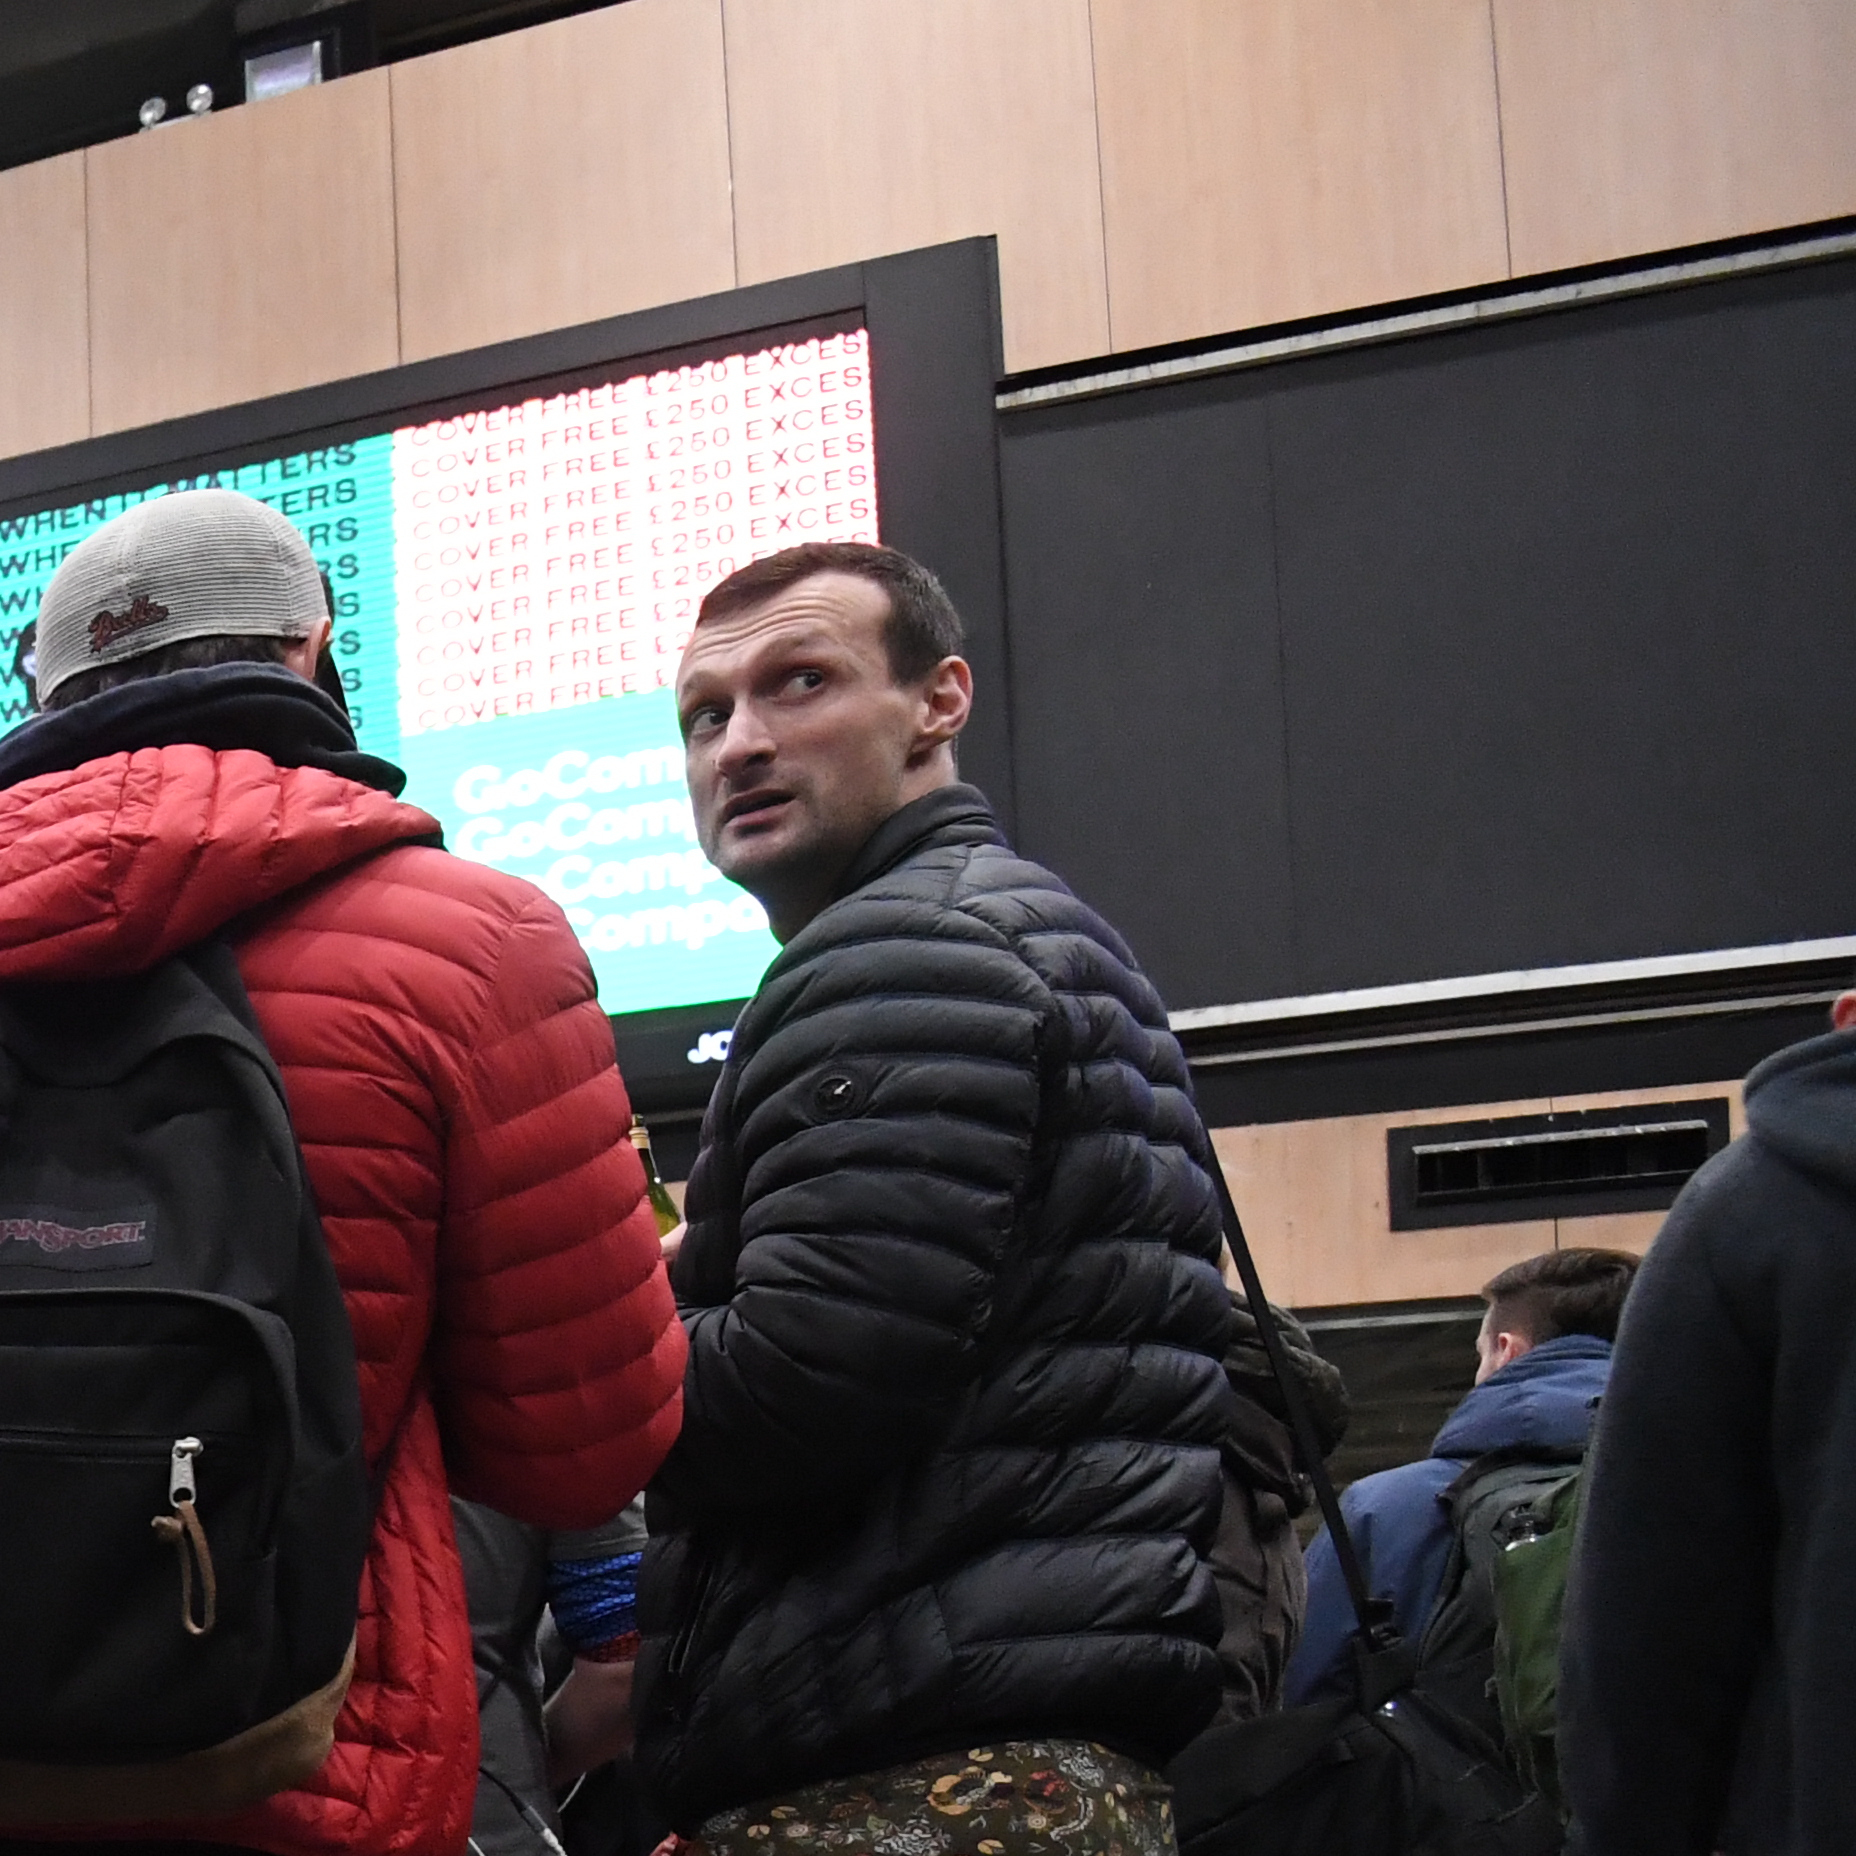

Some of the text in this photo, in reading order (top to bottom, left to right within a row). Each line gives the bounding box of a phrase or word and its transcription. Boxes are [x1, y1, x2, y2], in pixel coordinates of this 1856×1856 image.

[410, 412, 524, 447] COVER
[411, 366, 863, 478] COVER FREE £250 EXCES
[412, 400, 864, 509] COVER FREE £250 EXCES
[413, 433, 866, 540] COVER FREE £250 EXCES
[414, 466, 868, 571] COVER FREE £250 EXCES
[415, 500, 869, 602] COVER FREE £250 EXCES
[416, 596, 529, 634] COVER
[548, 576, 635, 610] FREE
[652, 557, 735, 589] £250
[417, 608, 636, 665] COVER FREE
[418, 640, 637, 696] COVER FREE
[419, 672, 638, 727] COVER FREE
[453, 745, 686, 814] GoCom
